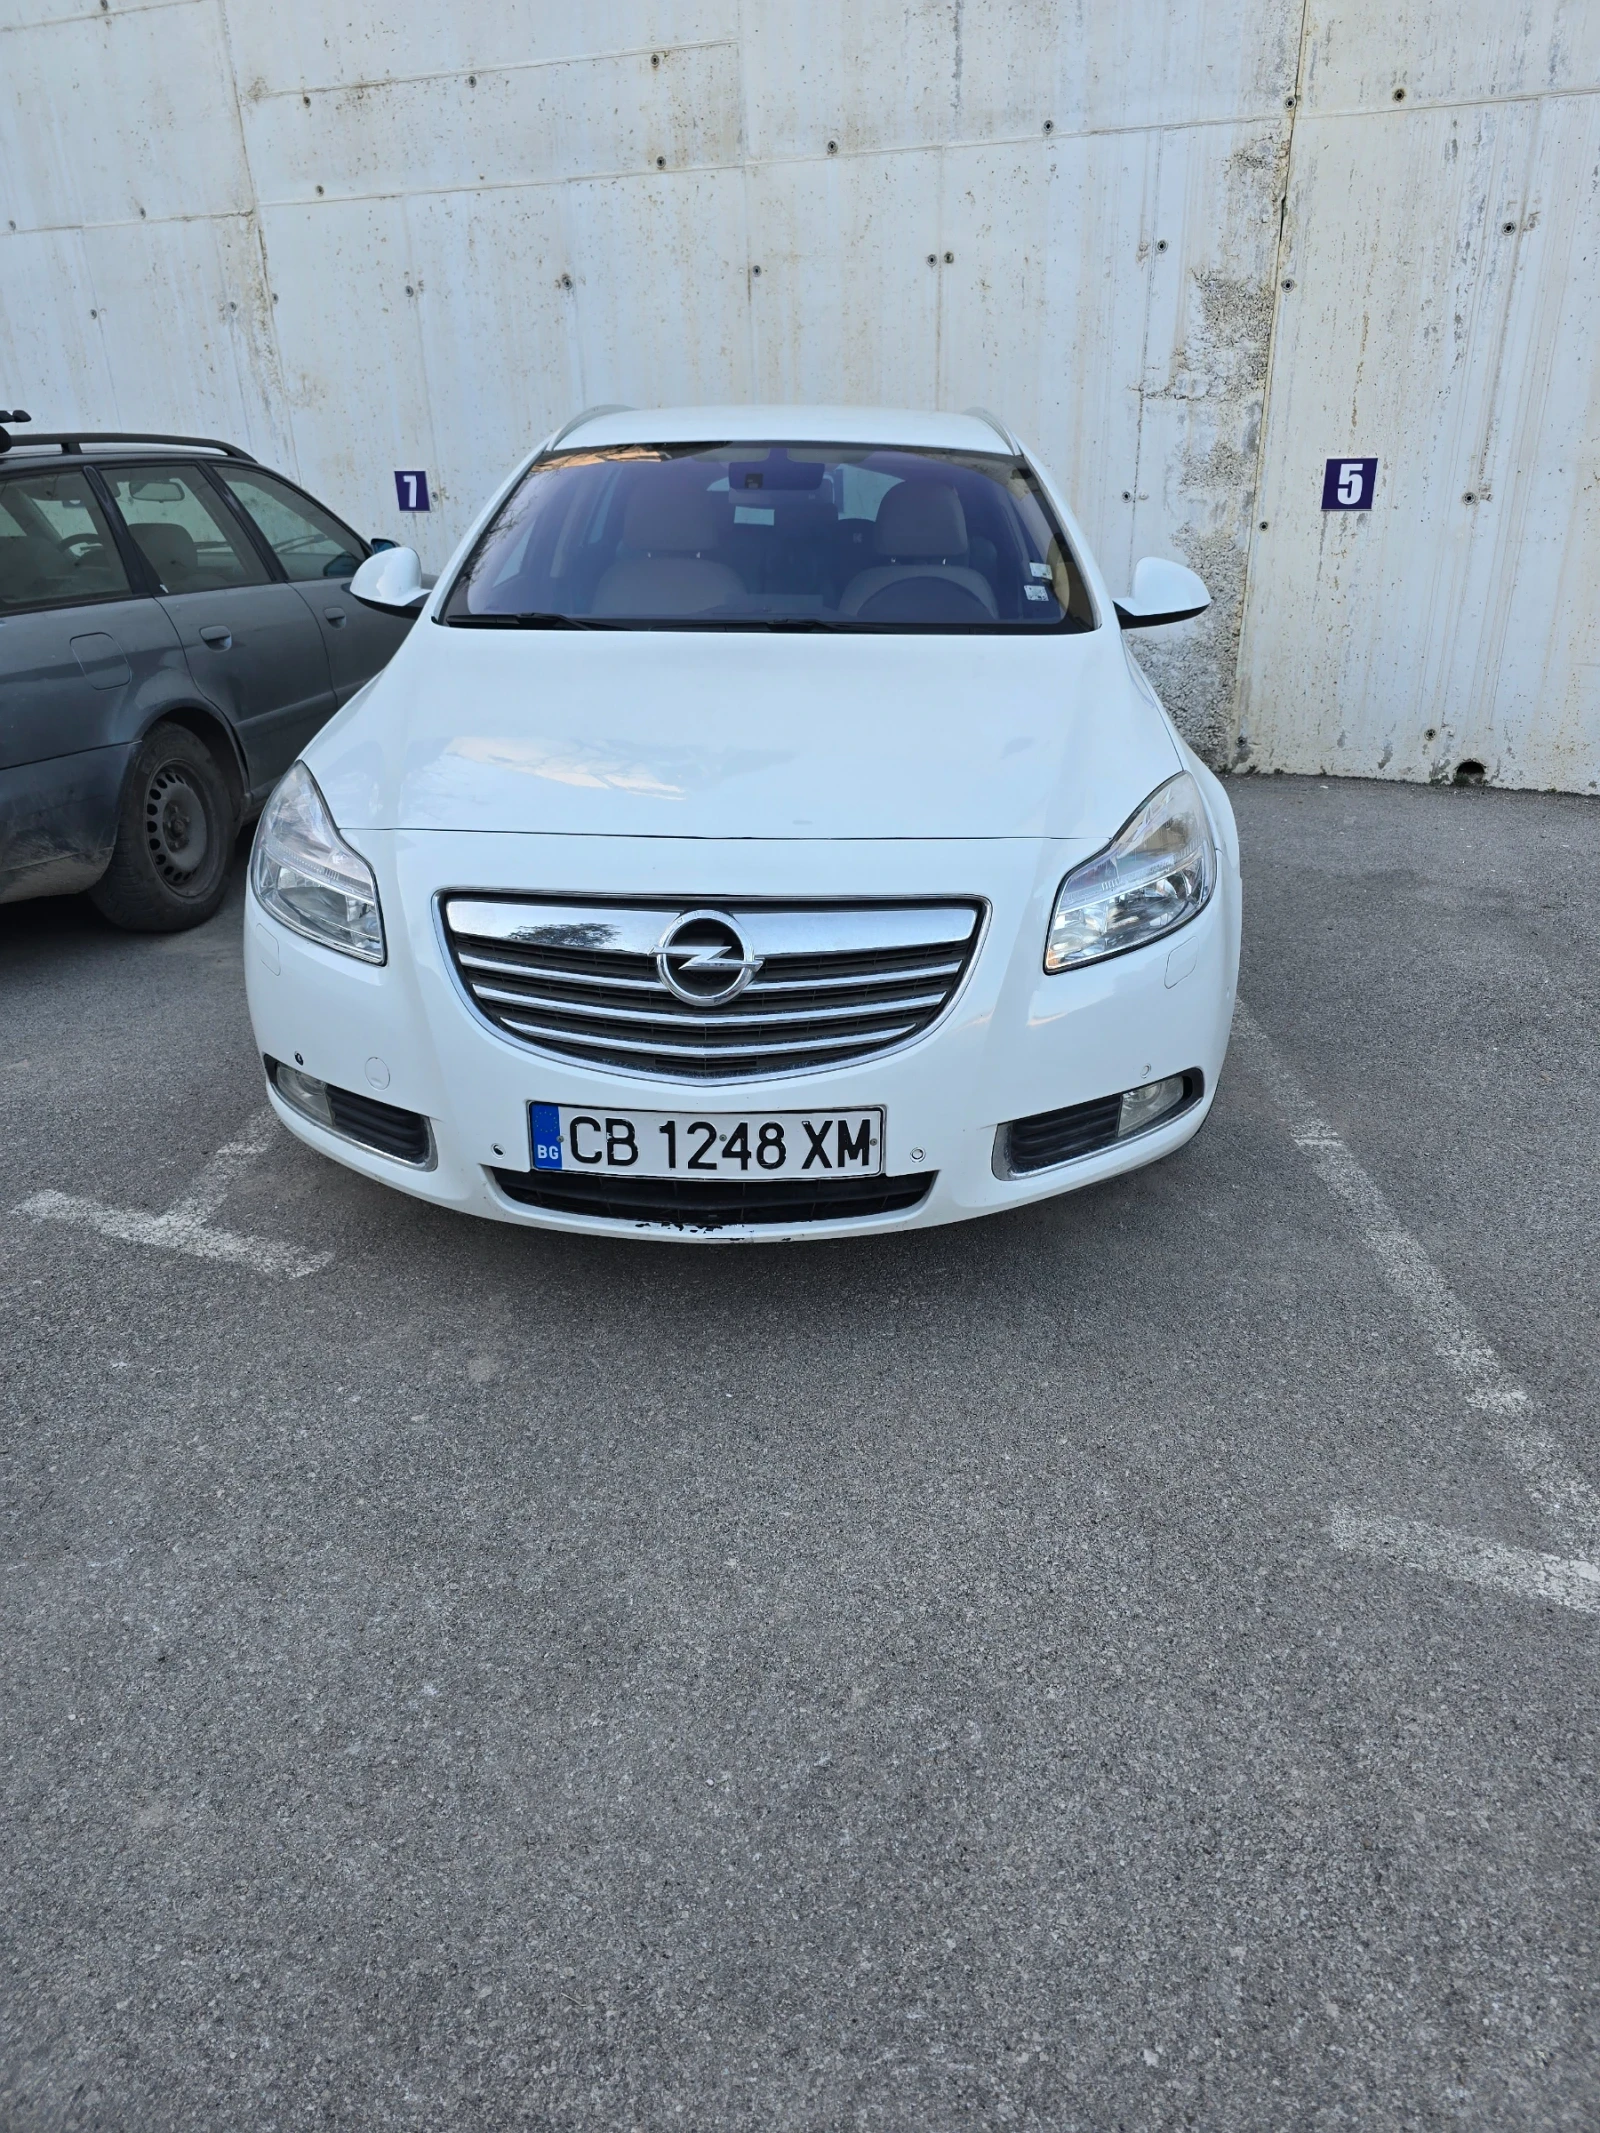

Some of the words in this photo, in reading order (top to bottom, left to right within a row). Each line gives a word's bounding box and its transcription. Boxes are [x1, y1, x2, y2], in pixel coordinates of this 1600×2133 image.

[1338, 464, 1363, 505] 5
[537, 1144, 559, 1160] BG
[570, 1116, 639, 1166] CB
[659, 1121, 787, 1170] 1248
[801, 1119, 871, 1169] XM
